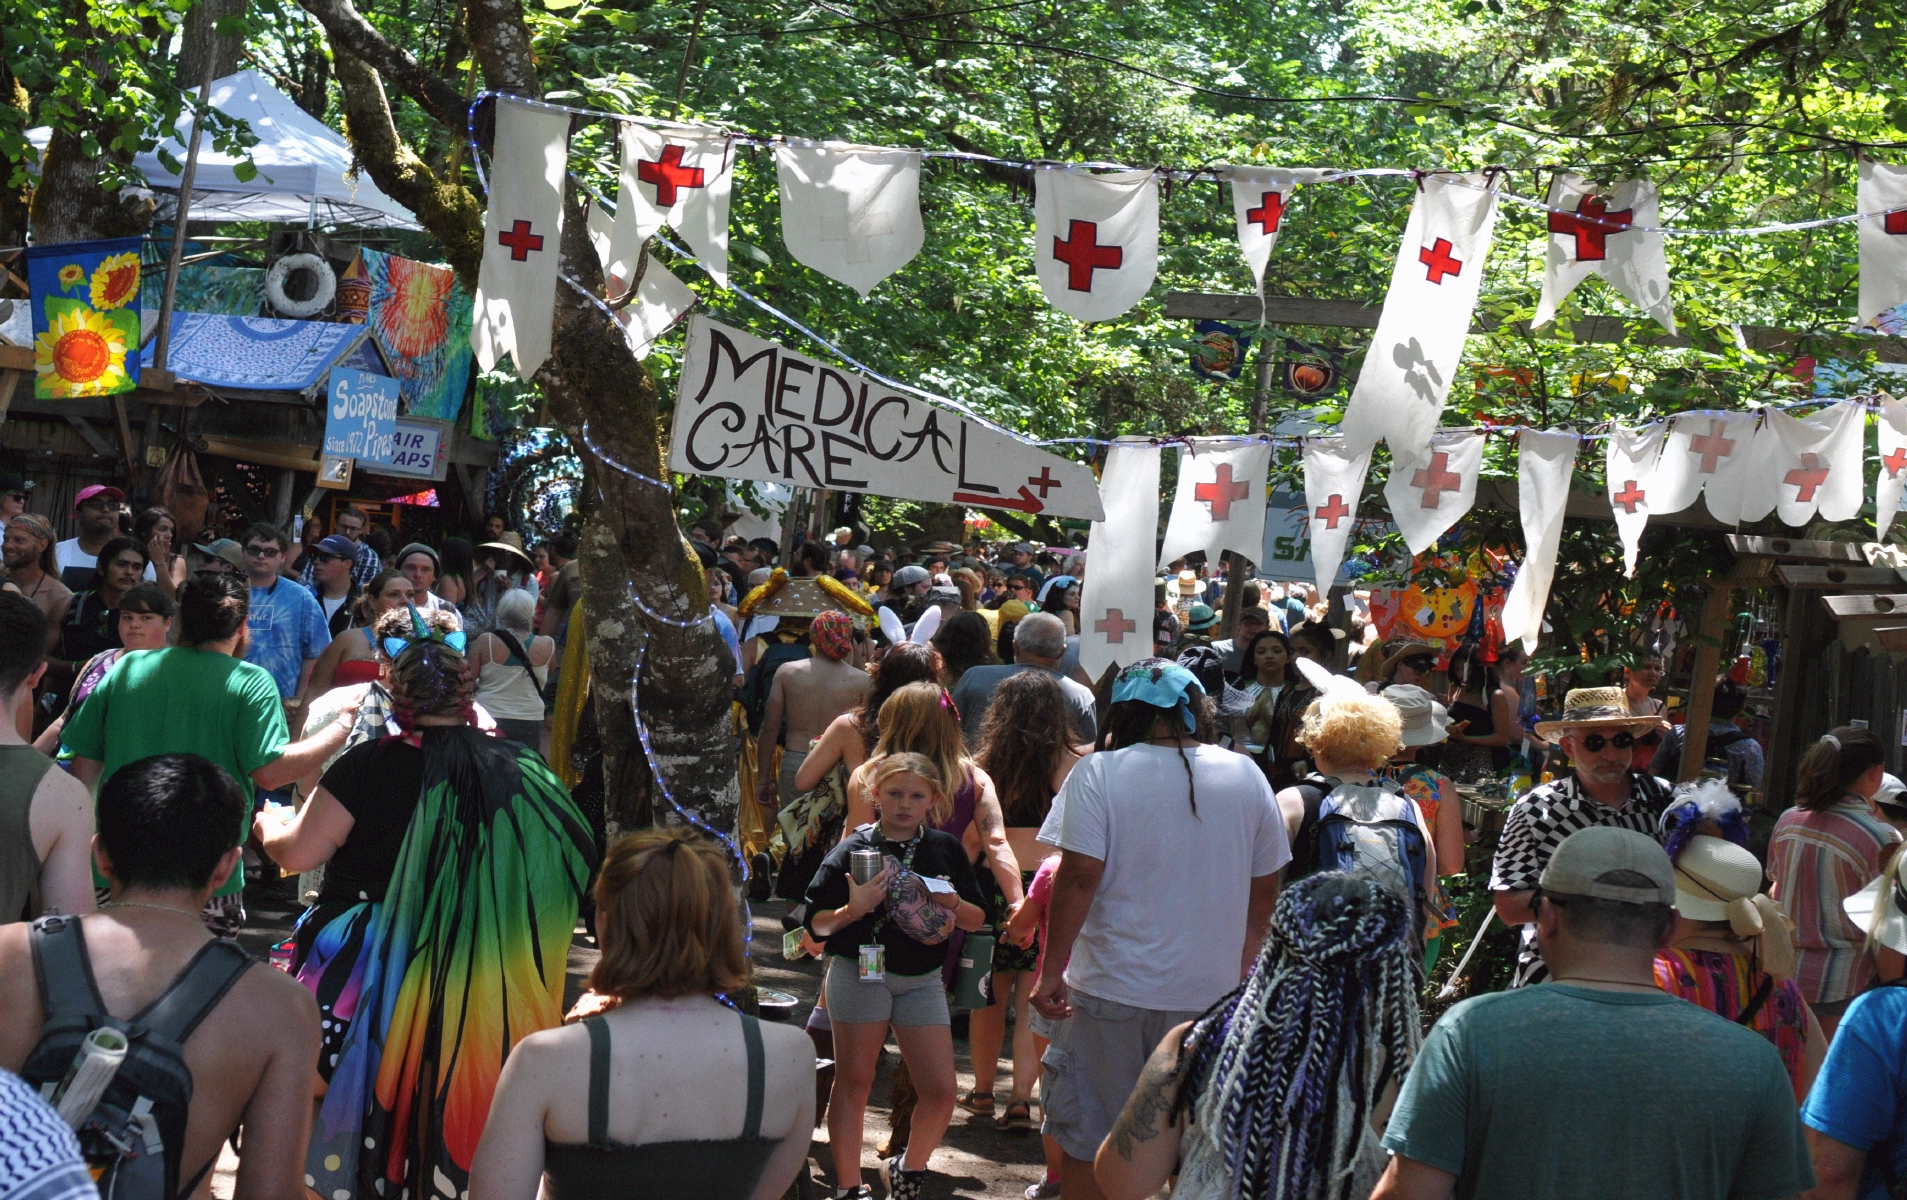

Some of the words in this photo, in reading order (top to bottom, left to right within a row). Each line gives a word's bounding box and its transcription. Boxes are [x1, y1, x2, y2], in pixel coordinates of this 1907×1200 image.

[333, 380, 397, 428] Soapstone
[696, 329, 999, 494] MEDICAL
[326, 437, 345, 453] Since
[345, 431, 363, 454] 1972
[363, 420, 393, 461] Pipes
[393, 432, 424, 449] AIR
[685, 402, 868, 489] CARE
[391, 450, 431, 468] APS
[1274, 536, 1312, 562] SA
